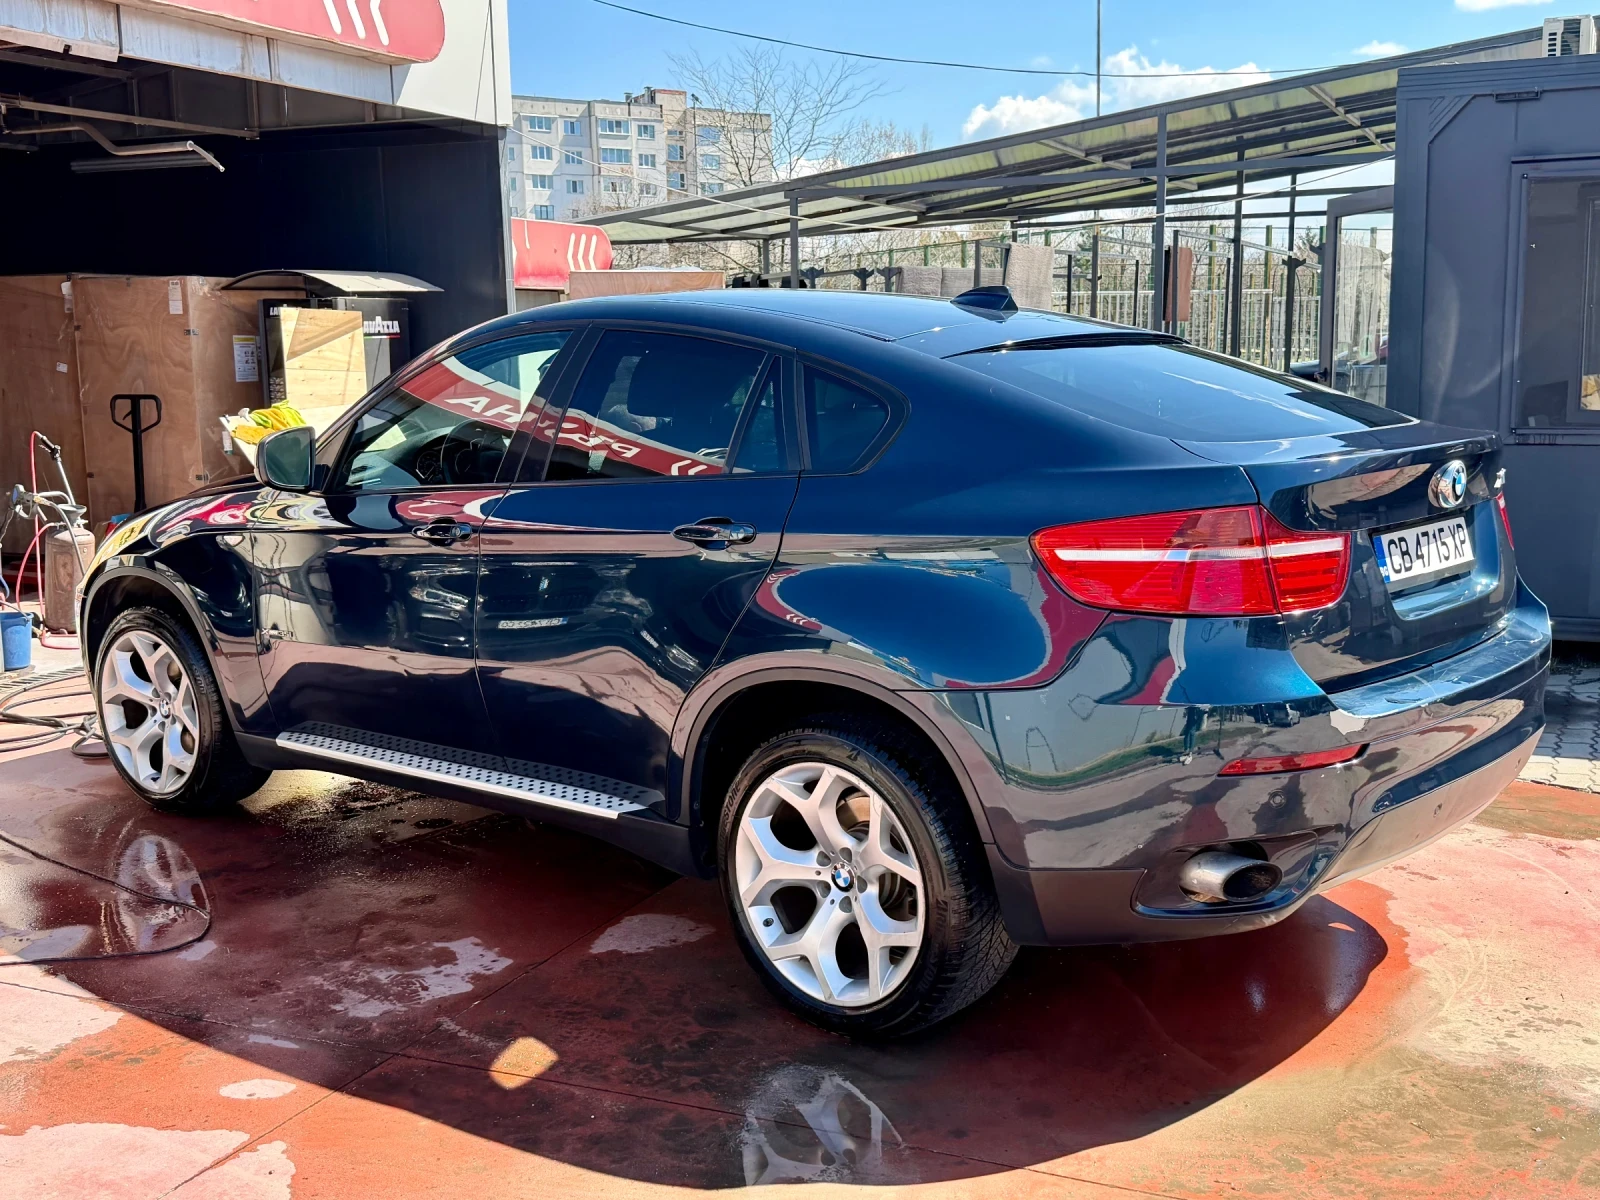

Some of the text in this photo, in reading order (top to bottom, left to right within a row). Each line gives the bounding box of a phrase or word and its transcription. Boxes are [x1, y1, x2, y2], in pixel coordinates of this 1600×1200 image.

[363, 315, 401, 334] AVAZZA
[1387, 523, 1466, 574] CB 4715 XP
